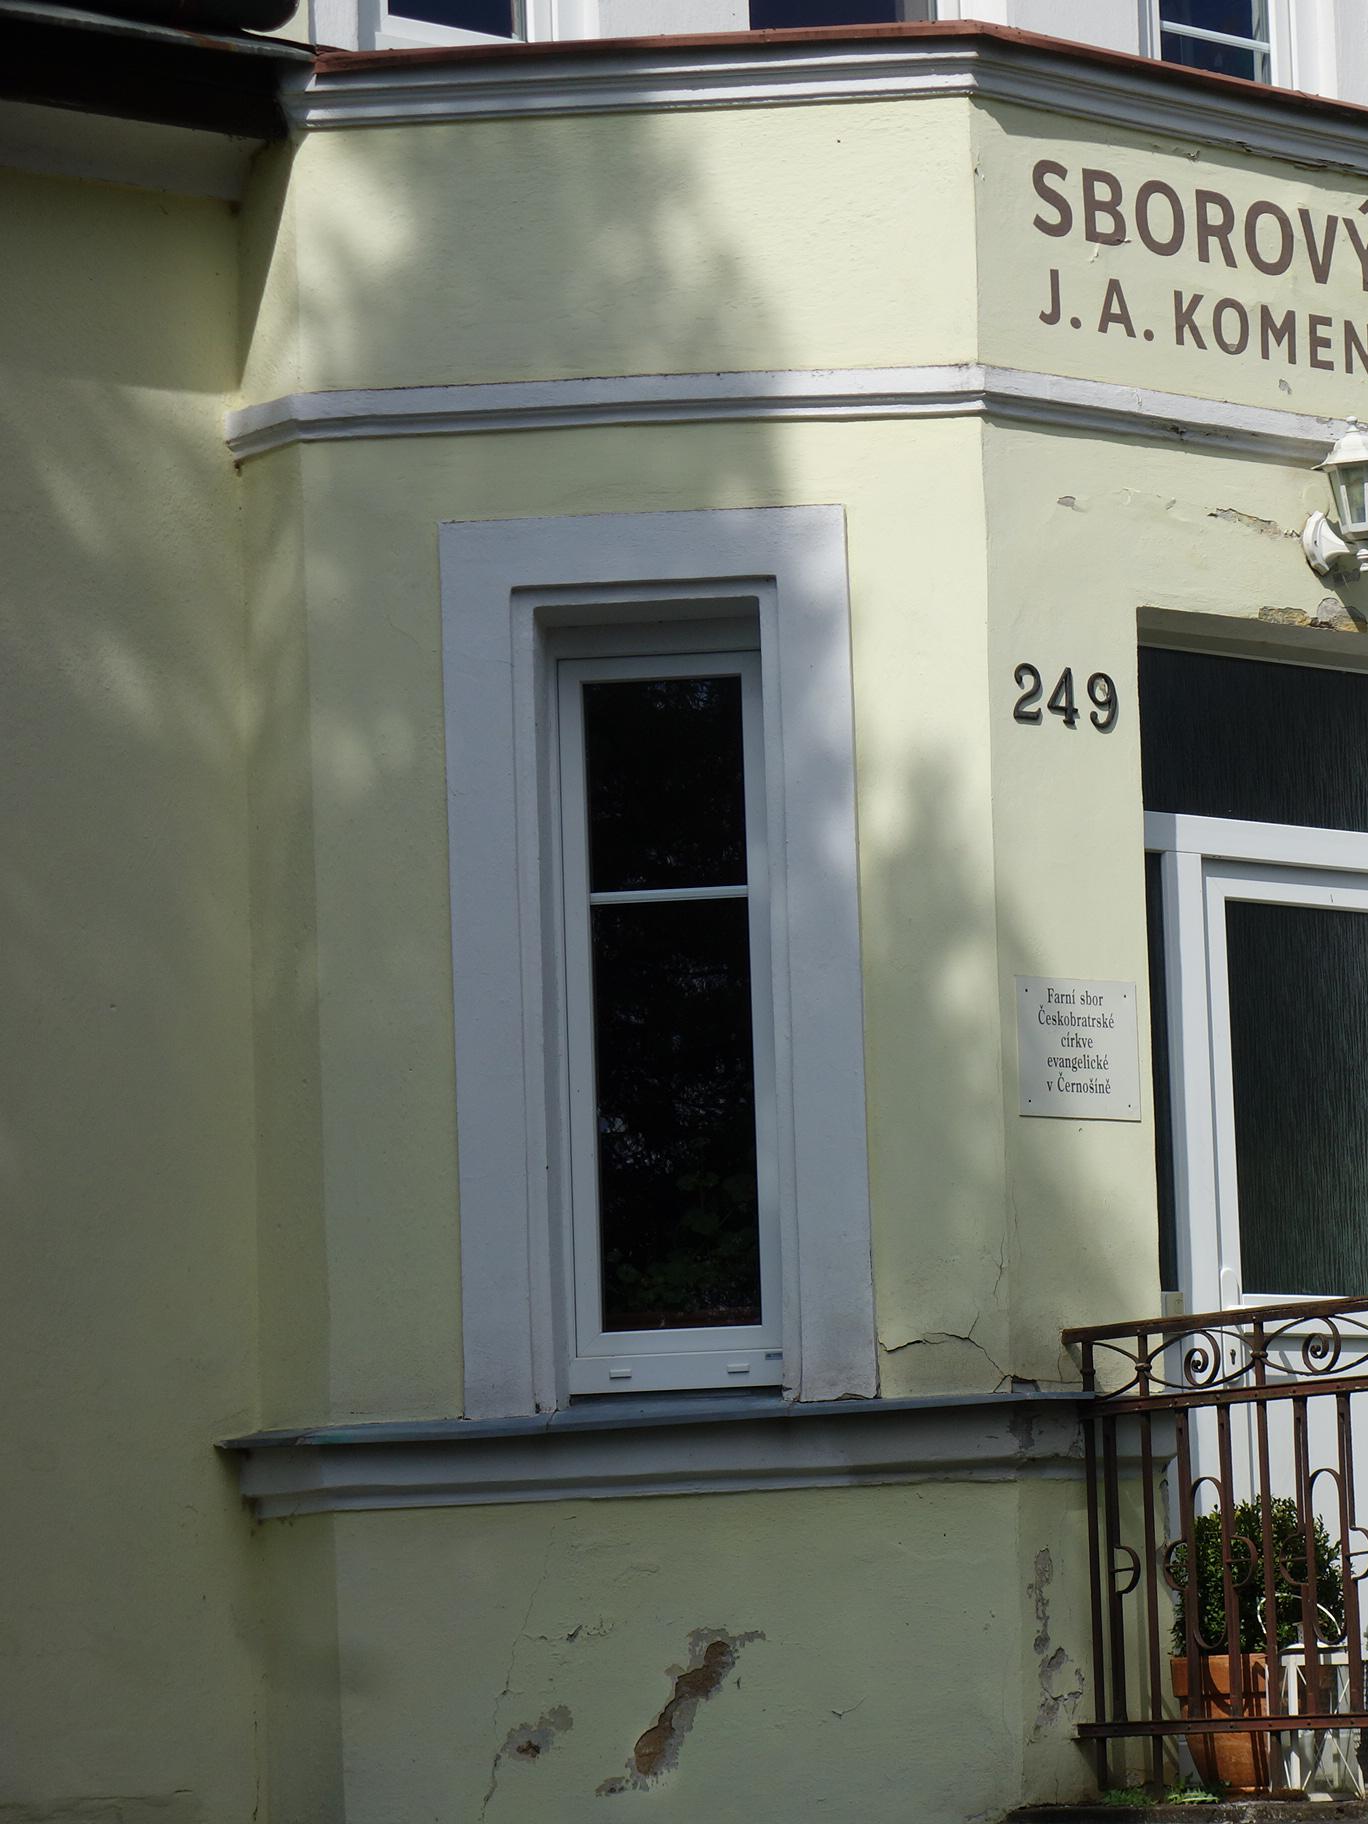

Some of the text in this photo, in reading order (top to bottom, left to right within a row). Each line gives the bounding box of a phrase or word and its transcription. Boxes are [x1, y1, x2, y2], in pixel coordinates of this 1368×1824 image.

[1038, 268, 1082, 330] J.
[1097, 278, 1155, 342] A.
[1013, 662, 1119, 731] 249
[1047, 987, 1104, 1006] Farní sbor
[1037, 1004, 1115, 1029] Českobratrské
[1061, 1031, 1094, 1049] církve
[1047, 1054, 1109, 1072] evangelické
[1046, 1071, 1112, 1095] v Černošíně
